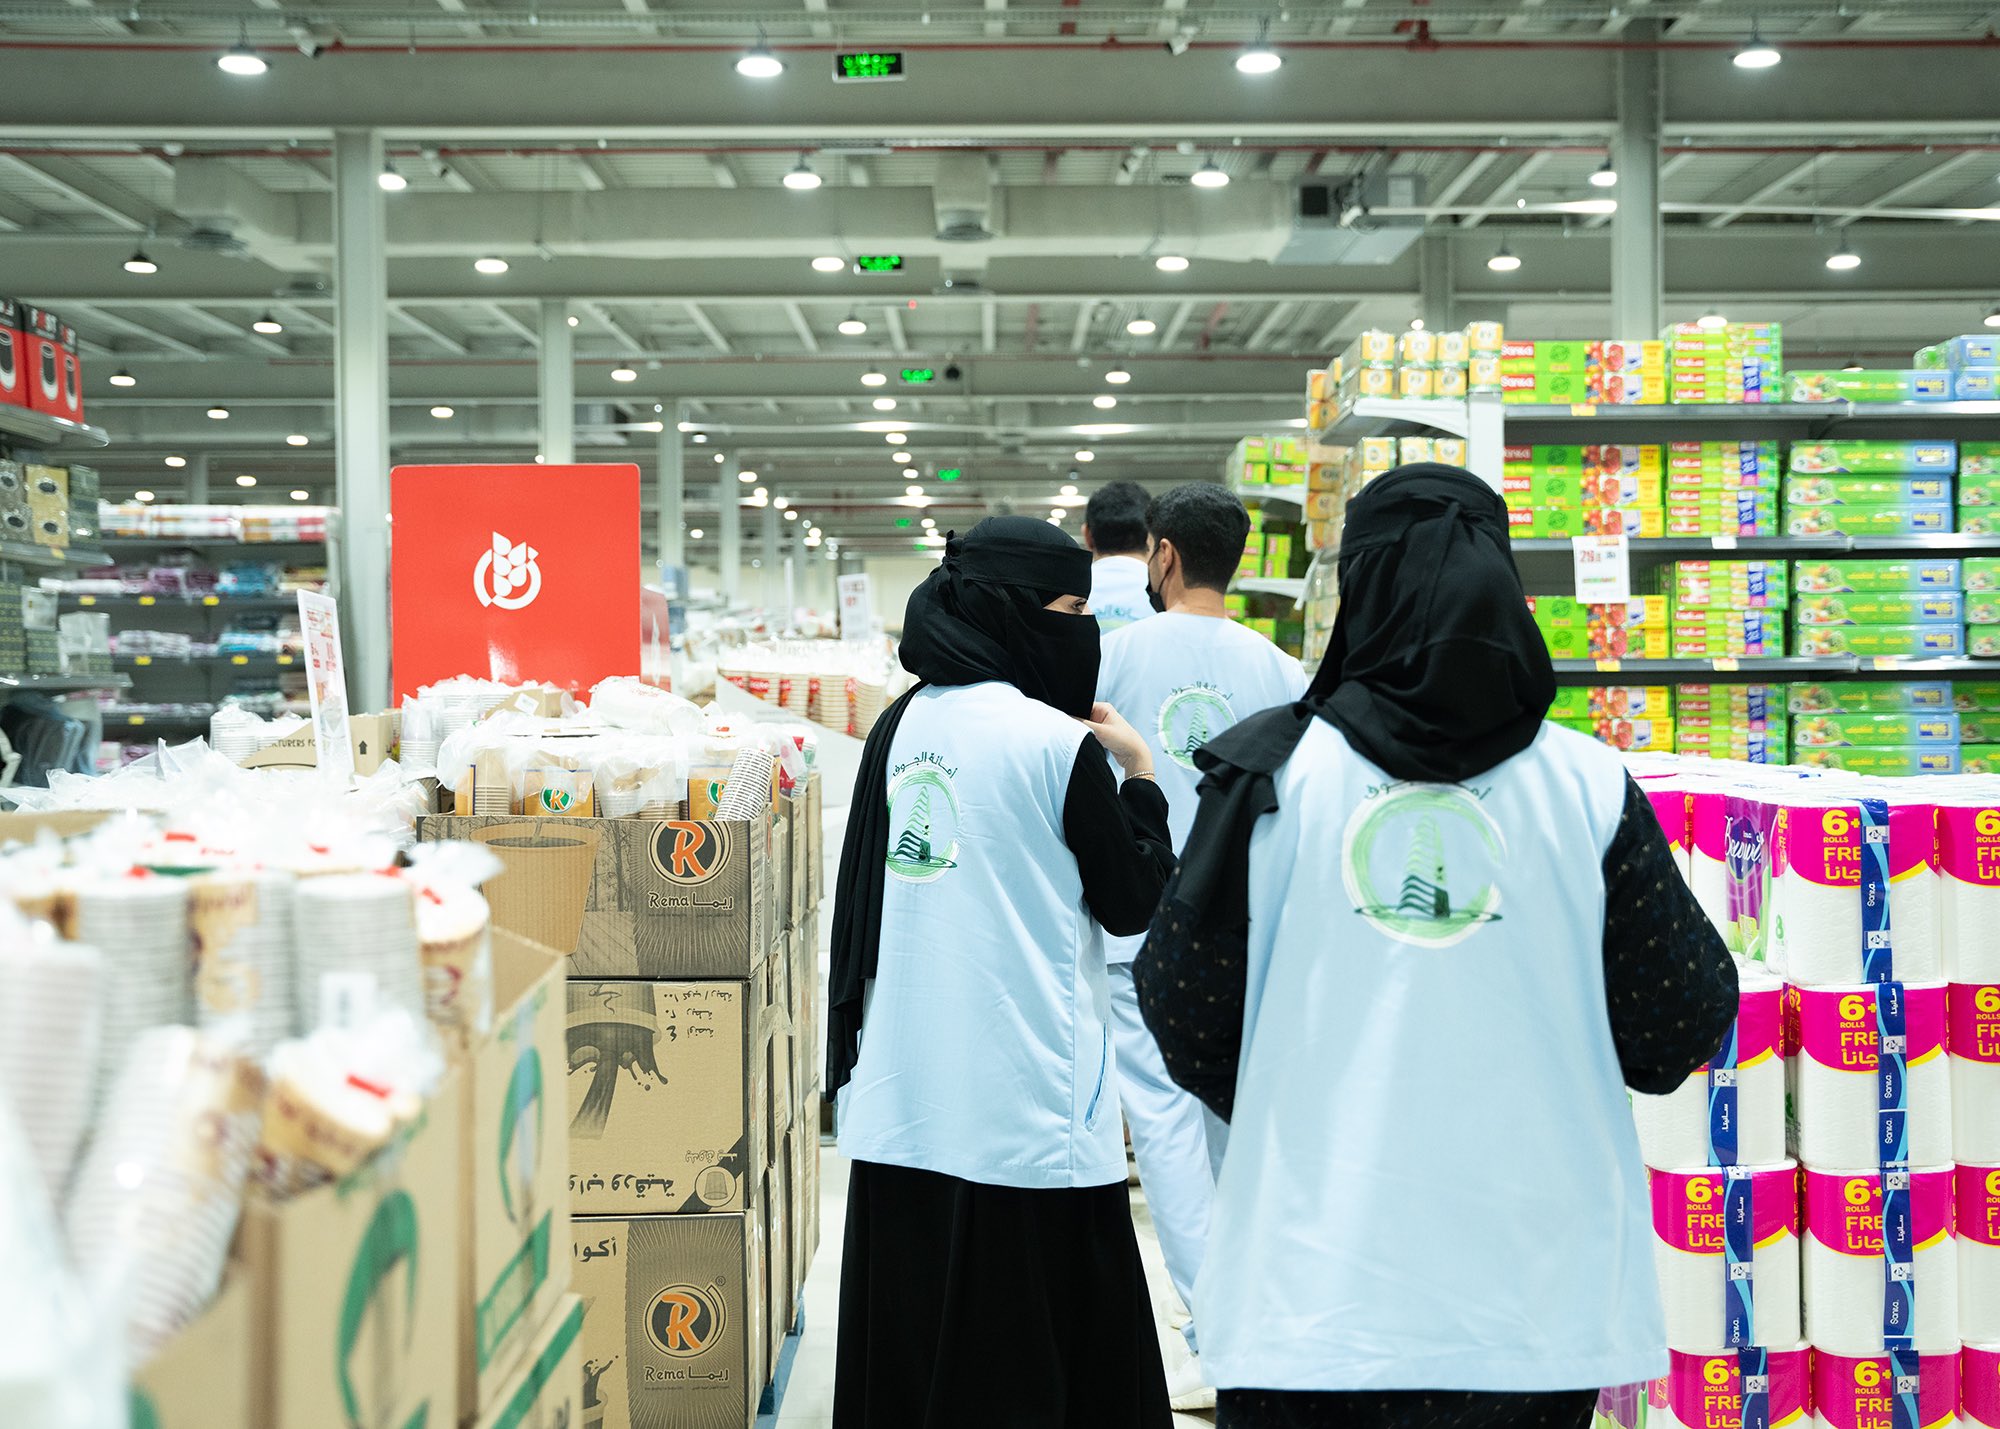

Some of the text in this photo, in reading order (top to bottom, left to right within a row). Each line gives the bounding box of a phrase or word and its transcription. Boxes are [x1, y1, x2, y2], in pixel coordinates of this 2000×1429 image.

[1824, 847, 1861, 861] FRE
[648, 892, 689, 908] Rema
[692, 892, 733, 910] ريما
[1840, 1032, 1878, 1047] FRE
[611, 1173, 675, 1198] ورقية
[1687, 1214, 1725, 1229] FRE
[1846, 1216, 1883, 1231] FRE
[573, 1236, 617, 1262] أكوا
[661, 1294, 700, 1349] R
[645, 1366, 685, 1381] Rema
[688, 1365, 729, 1381] ريما
[1704, 1396, 1741, 1410] FRE
[1855, 1398, 1892, 1412] FRE
